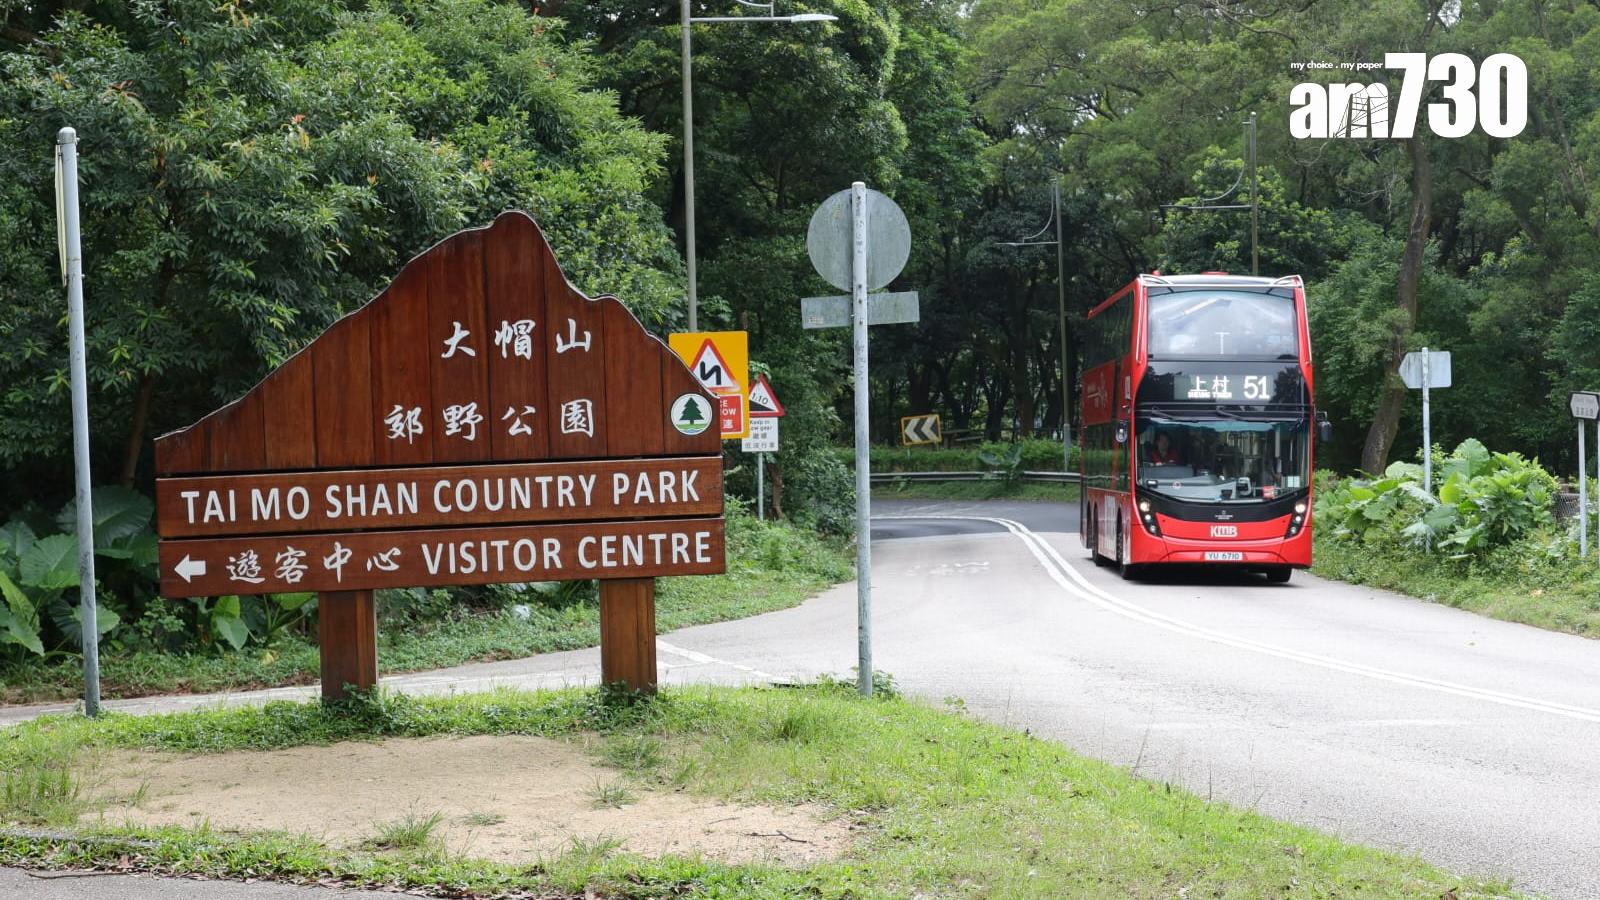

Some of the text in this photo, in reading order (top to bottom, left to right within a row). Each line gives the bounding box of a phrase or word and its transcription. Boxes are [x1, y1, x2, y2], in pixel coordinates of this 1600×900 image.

[441, 318, 592, 360] 大帽山
[1190, 375, 1270, 399] 上村 51
[384, 399, 594, 444] 郊野公園
[181, 469, 700, 524] TAI MO SHAN COUNTRY PARK
[1210, 525, 1238, 538] KMB
[226, 531, 712, 584] 遊客中心 VISITOR CENTRE
